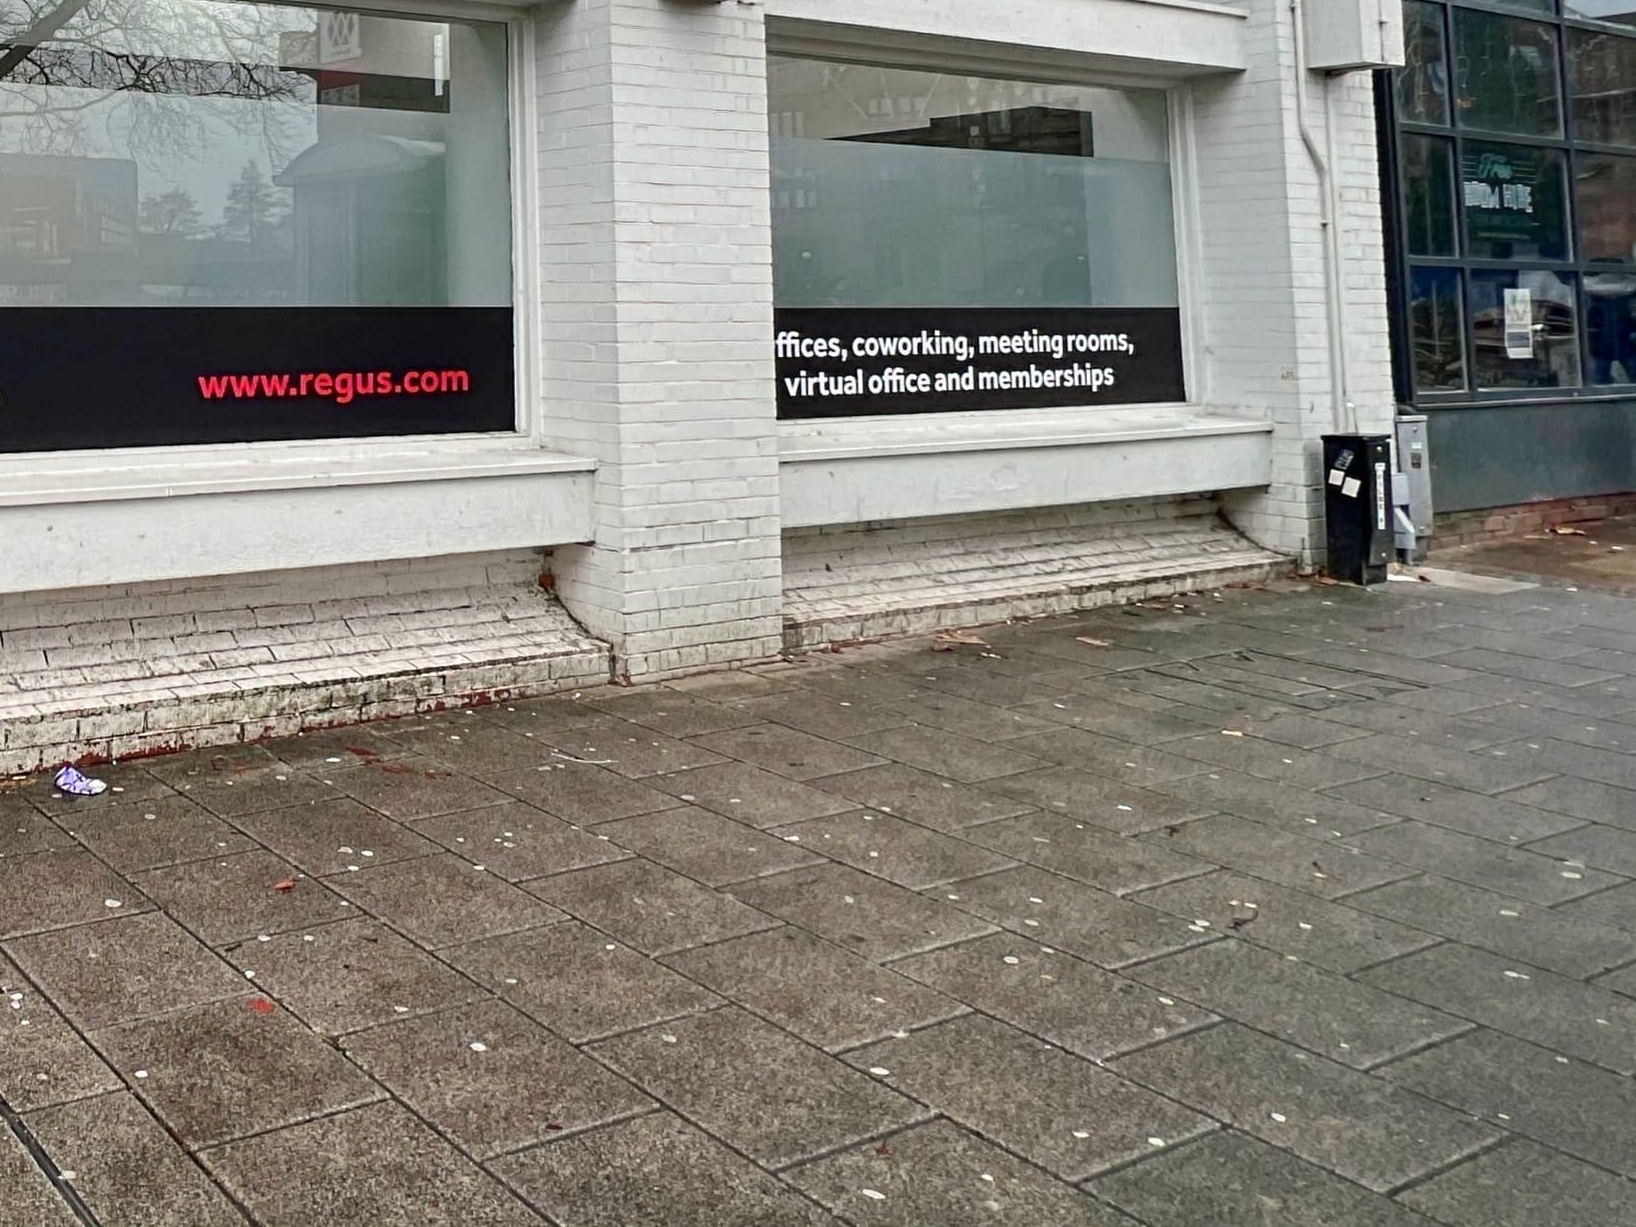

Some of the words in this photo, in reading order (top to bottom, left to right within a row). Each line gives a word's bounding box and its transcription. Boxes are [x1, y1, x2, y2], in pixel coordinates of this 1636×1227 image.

[851, 329, 975, 362] coworking,
[978, 328, 1064, 359] meeting
[1067, 333, 1134, 355] rooms,
[198, 370, 469, 404] www.regus.com
[784, 368, 864, 396] virtual
[867, 367, 931, 394] office
[934, 365, 974, 392] and
[978, 362, 1115, 393] memberships
